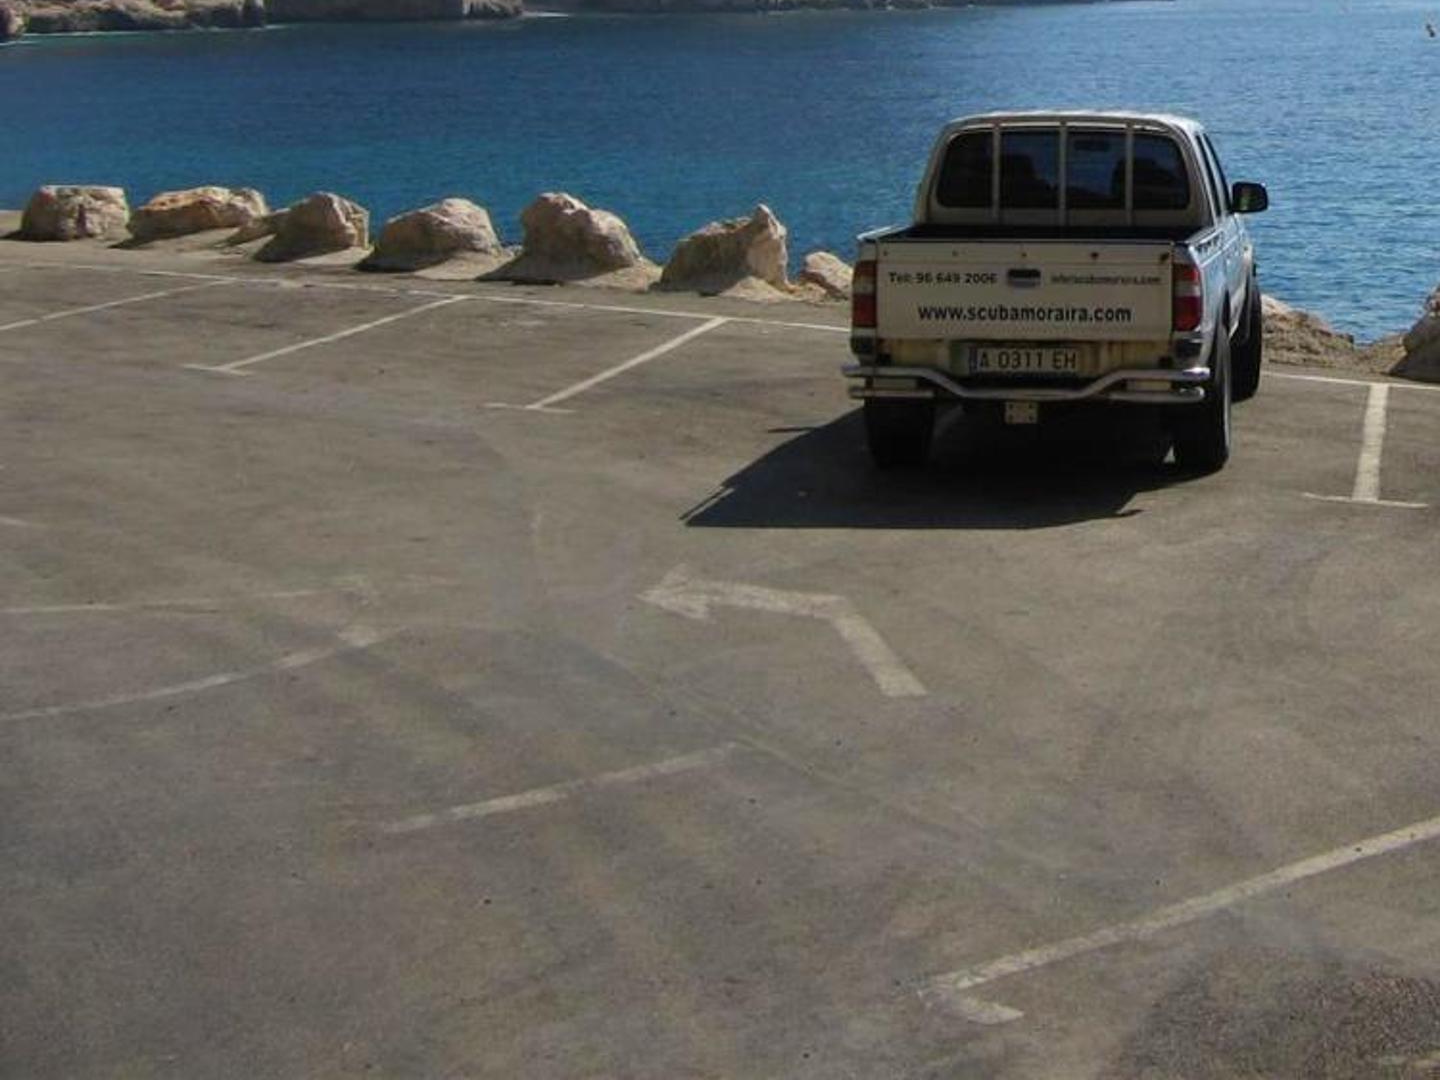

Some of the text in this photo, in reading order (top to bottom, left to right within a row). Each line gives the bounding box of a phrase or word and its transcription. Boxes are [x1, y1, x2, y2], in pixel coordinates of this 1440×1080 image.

[964, 272, 998, 284] 2006
[918, 304, 1132, 322] www.scubamoraira.com
[978, 351, 1077, 369] A 0311 EH
